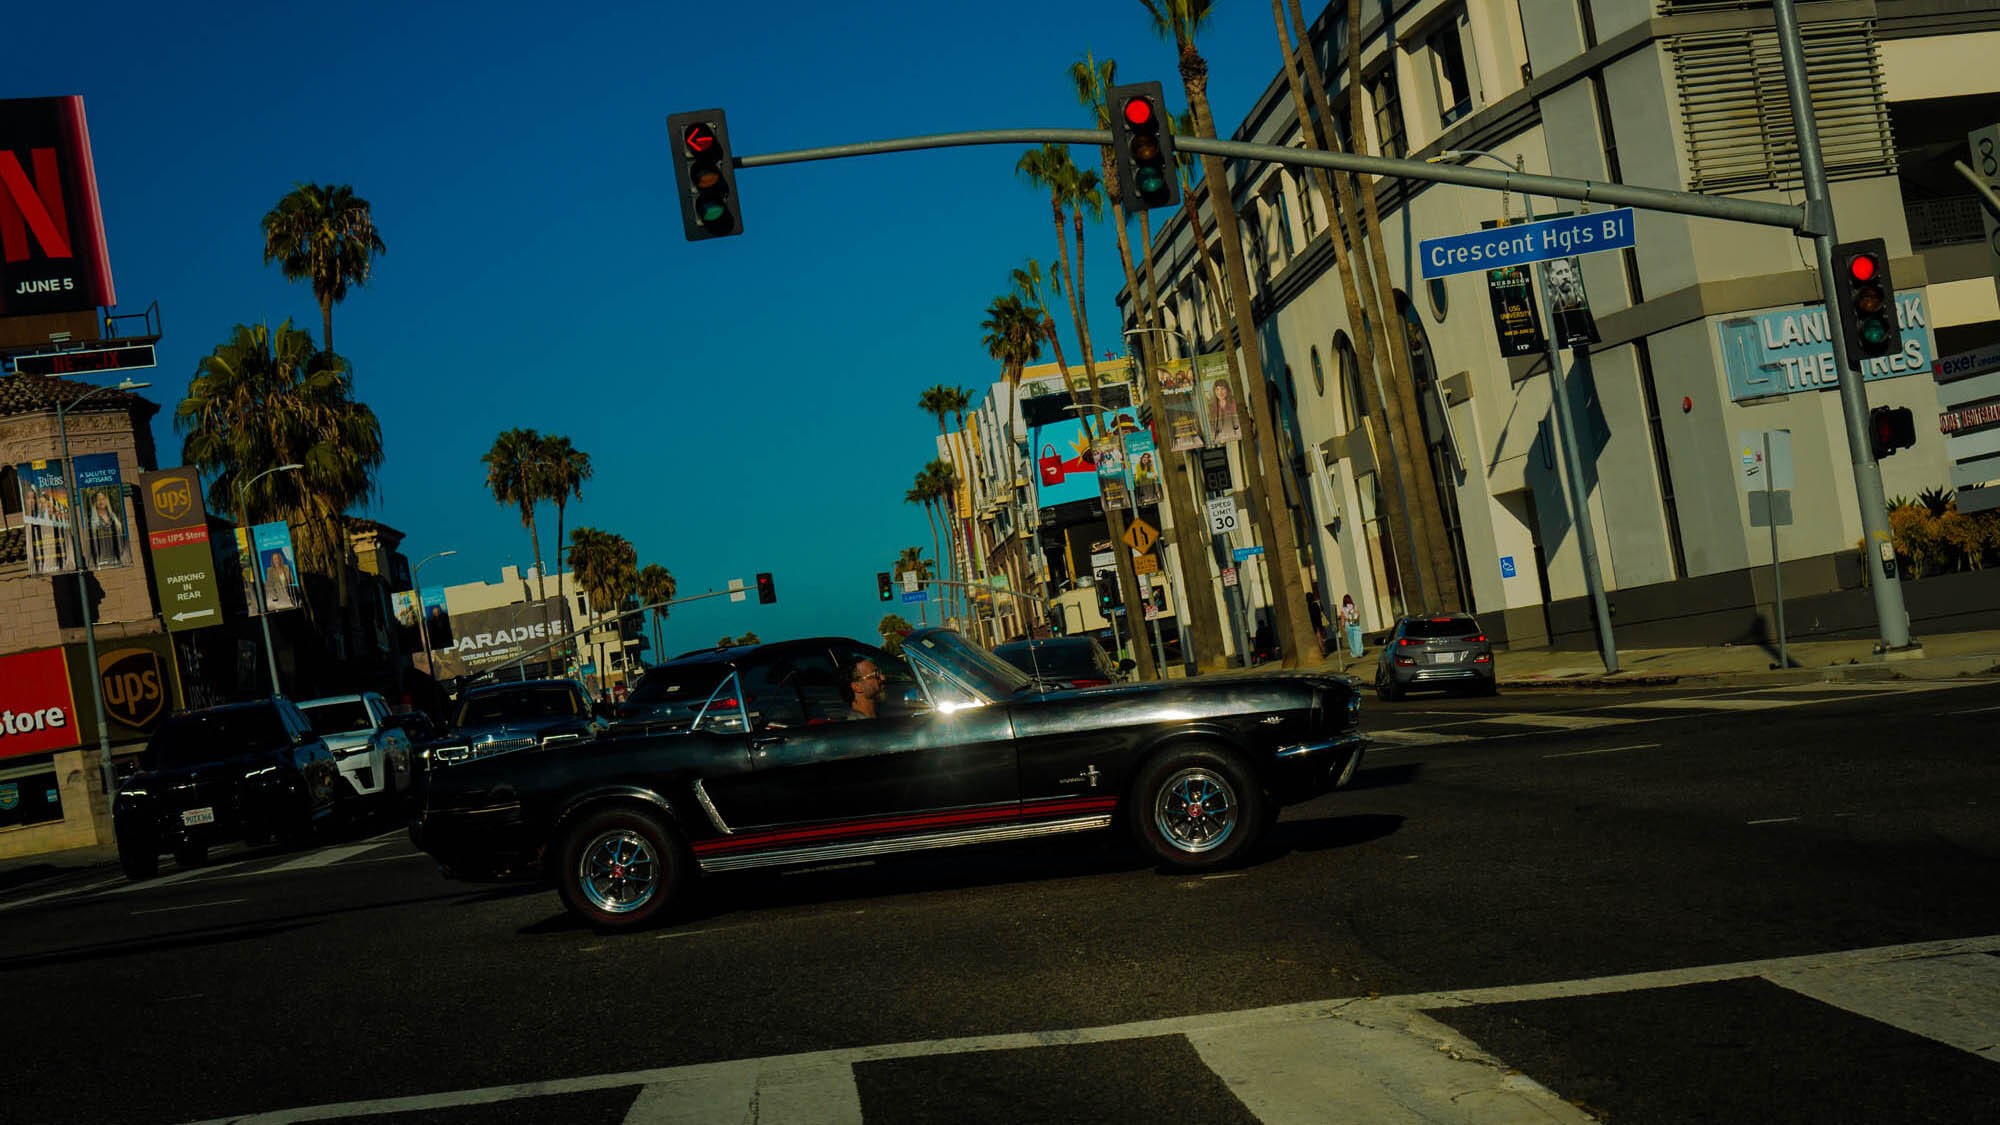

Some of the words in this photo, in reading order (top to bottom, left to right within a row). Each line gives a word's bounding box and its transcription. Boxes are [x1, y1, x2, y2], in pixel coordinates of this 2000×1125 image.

[1431, 233, 1534, 267] Crescent
[1542, 226, 1594, 253] Hgts
[16, 278, 61, 295] JUNE
[63, 277, 74, 291] 5
[1780, 339, 1924, 389] THERES
[1943, 354, 1977, 374] exer
[84, 475, 113, 484] ARTISANS
[85, 469, 107, 477] SALUTE
[156, 489, 188, 513] ups
[1210, 501, 1232, 509] SPEED
[1213, 508, 1231, 517] LIMIT
[1215, 516, 1235, 530] 30
[152, 534, 167, 545] The
[168, 533, 184, 543] UPS
[185, 530, 207, 541] Store
[167, 571, 206, 585] PARKING
[183, 583, 192, 591] IN
[177, 591, 201, 601] REAR
[443, 620, 567, 655] PARADISE
[104, 670, 159, 716] ups
